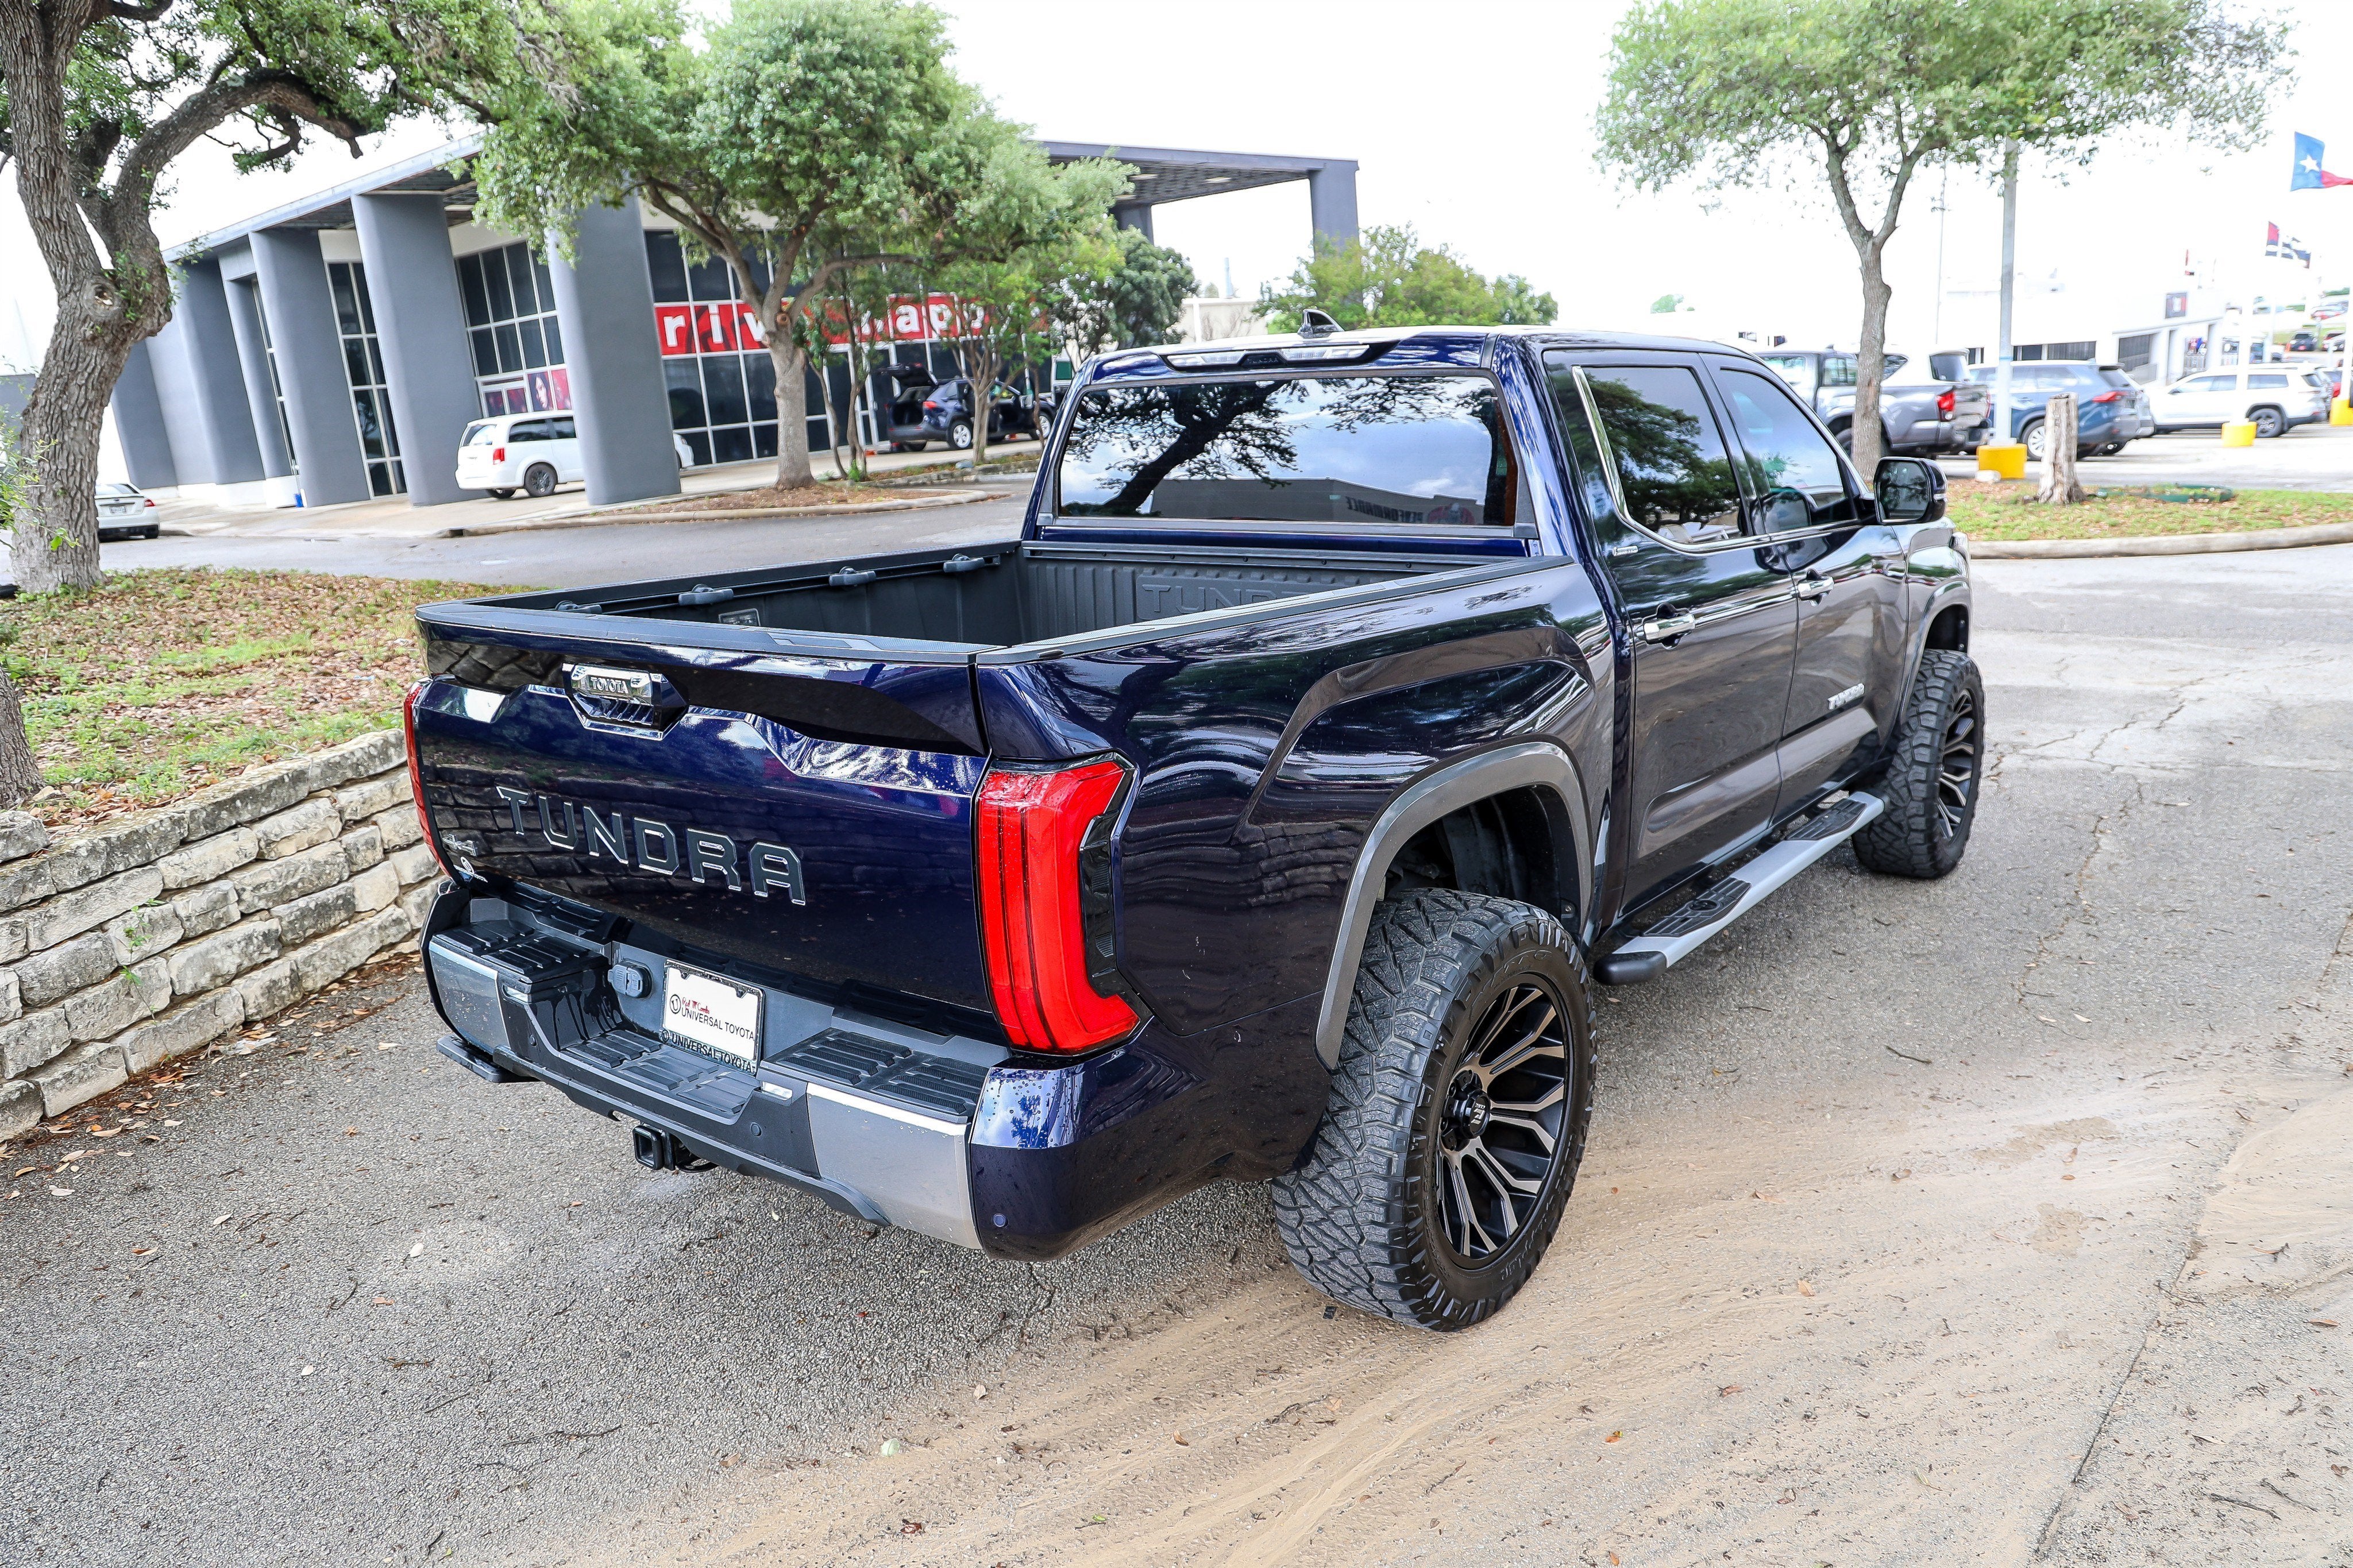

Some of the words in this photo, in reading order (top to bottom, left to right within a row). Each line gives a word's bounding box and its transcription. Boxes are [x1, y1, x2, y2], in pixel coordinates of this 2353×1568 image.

[664, 303, 766, 347] riv
[590, 677, 629, 694] TOYOTA
[495, 784, 806, 906] TUNDRA
[681, 1007, 723, 1030] UNIVERSAL
[724, 1022, 755, 1042] TOYOTA
[672, 1033, 719, 1060] UNIVERSAL
[720, 1051, 754, 1073] TOYOTA
